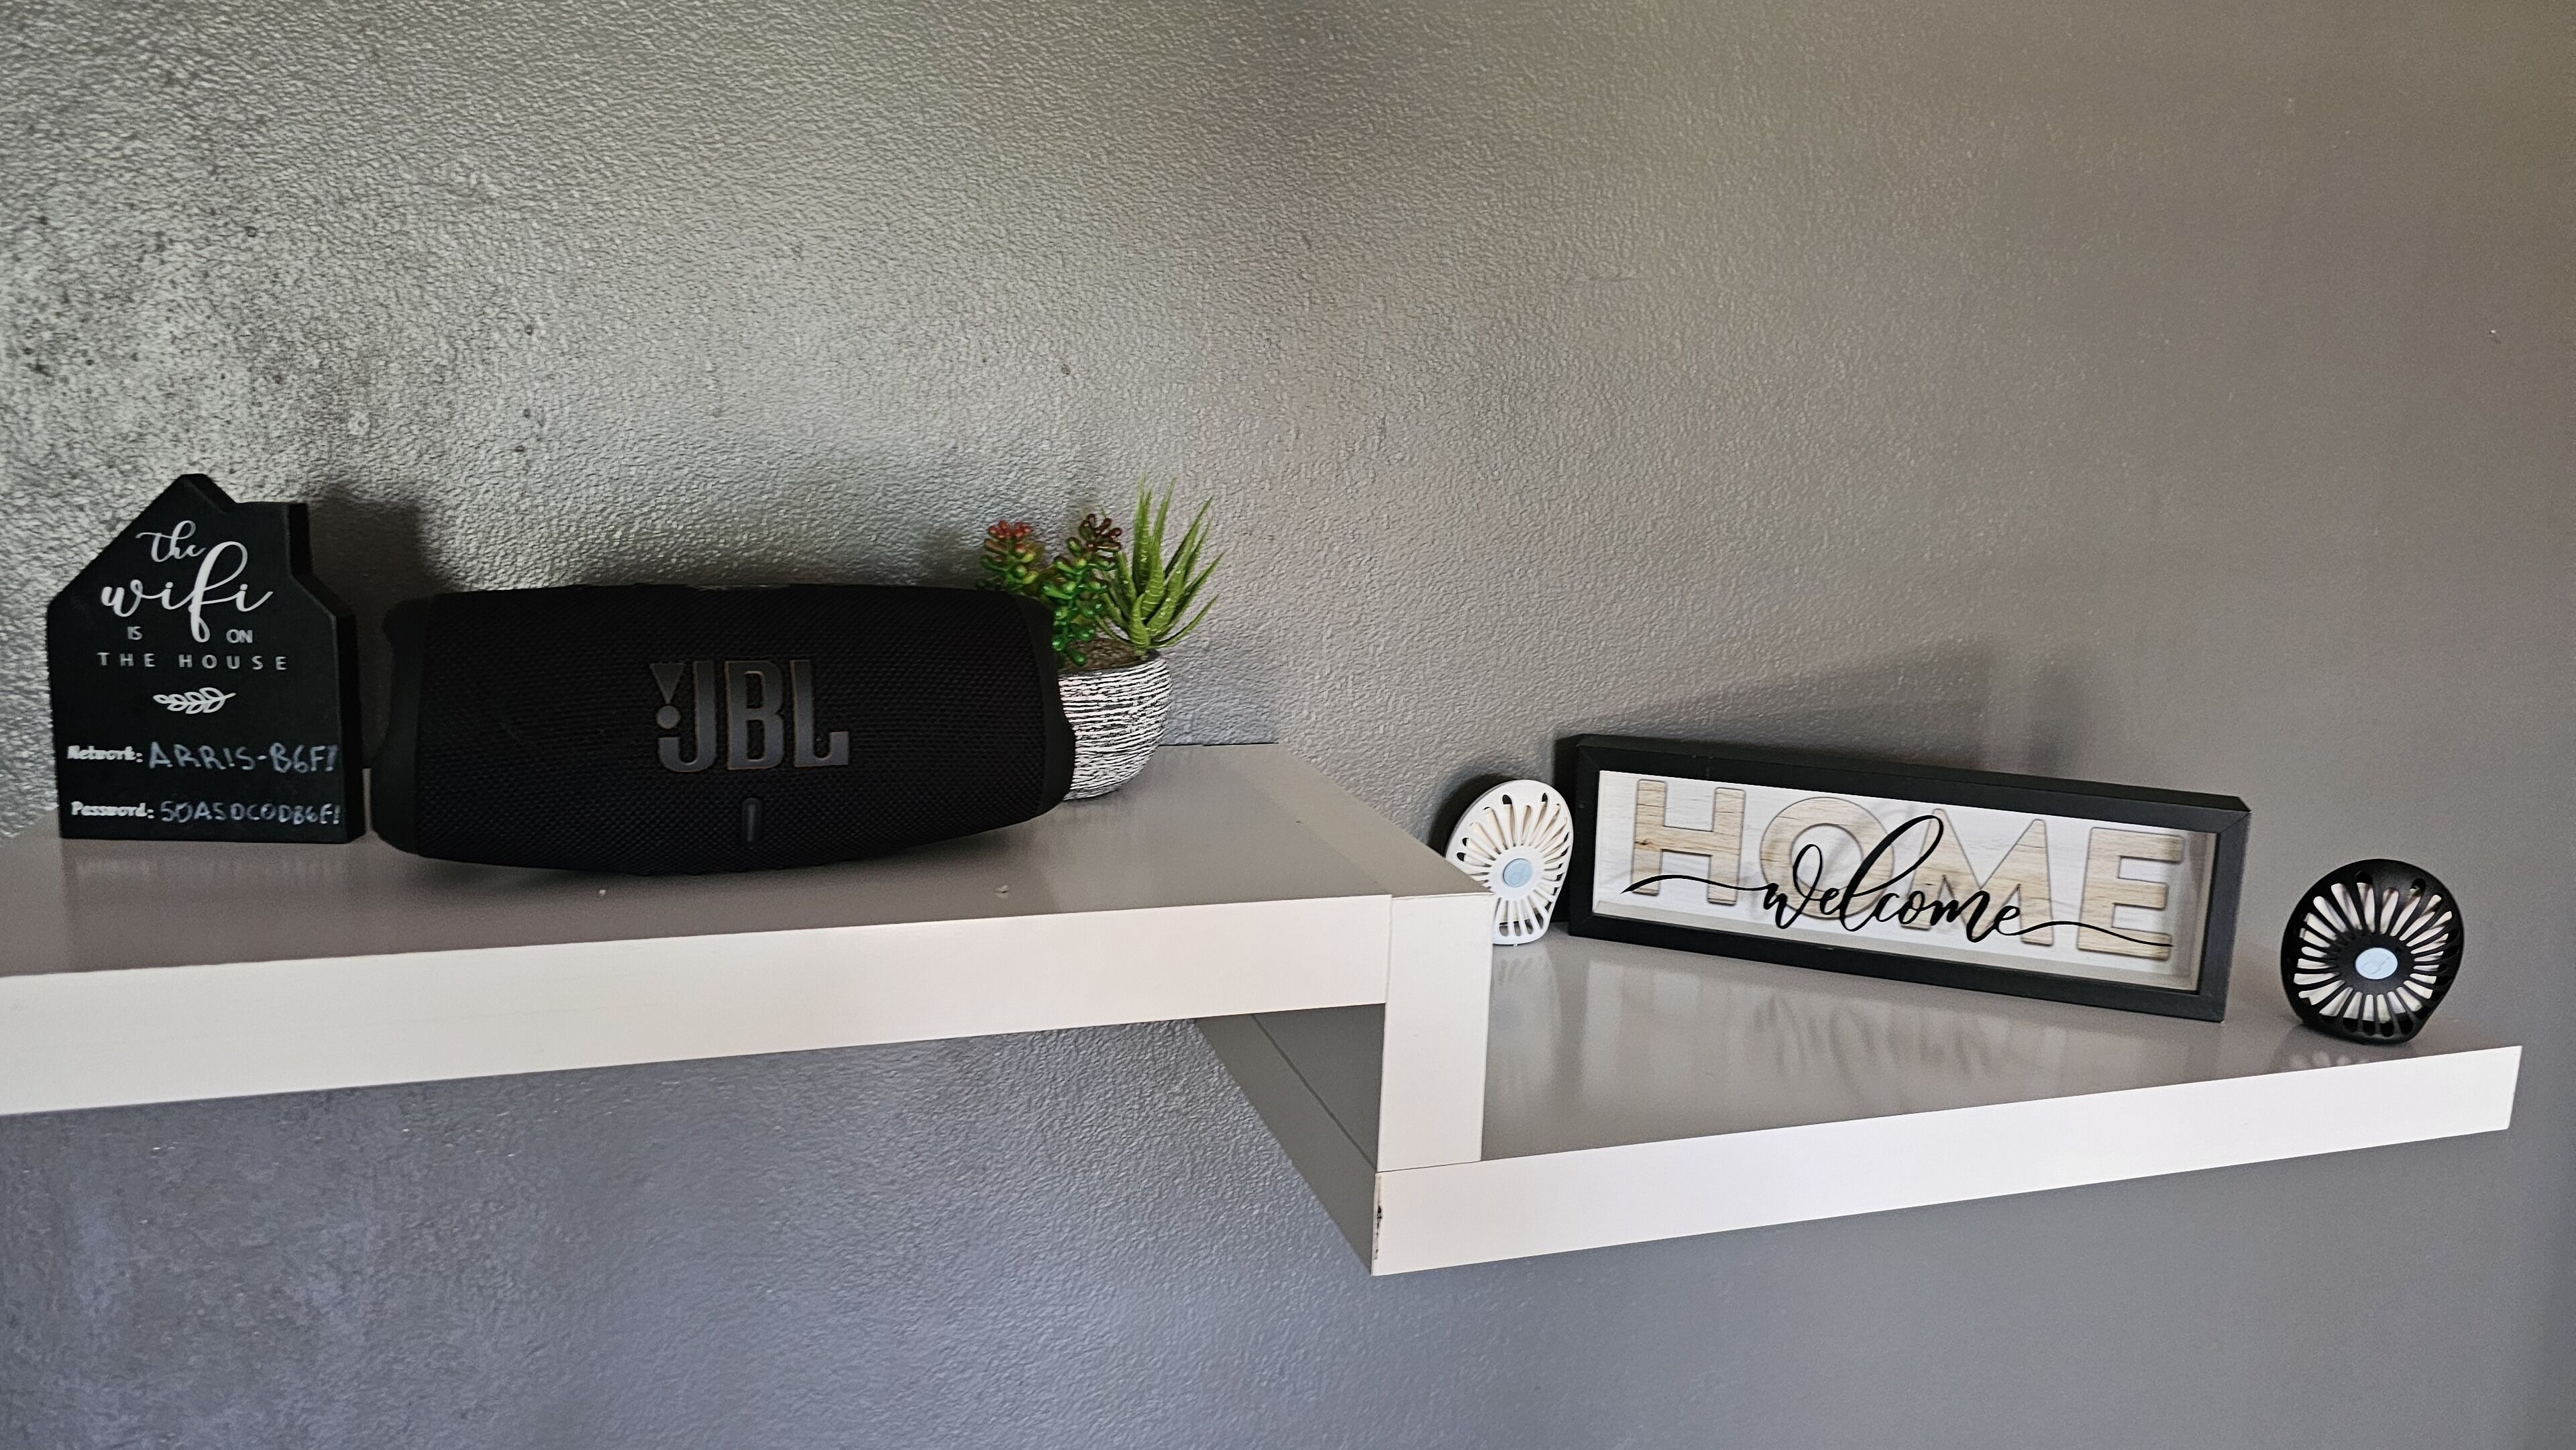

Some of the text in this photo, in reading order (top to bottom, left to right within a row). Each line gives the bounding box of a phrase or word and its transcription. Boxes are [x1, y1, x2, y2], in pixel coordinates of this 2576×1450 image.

[100, 541, 274, 643] wifi
[97, 652, 288, 670] THE HOUSE
[127, 626, 254, 643] IS ON
[649, 659, 850, 772] JBL
[67, 745, 144, 763] Network:
[71, 800, 155, 819] Password:
[1621, 815, 2174, 947] welcome
[1630, 778, 2186, 961] HOME
